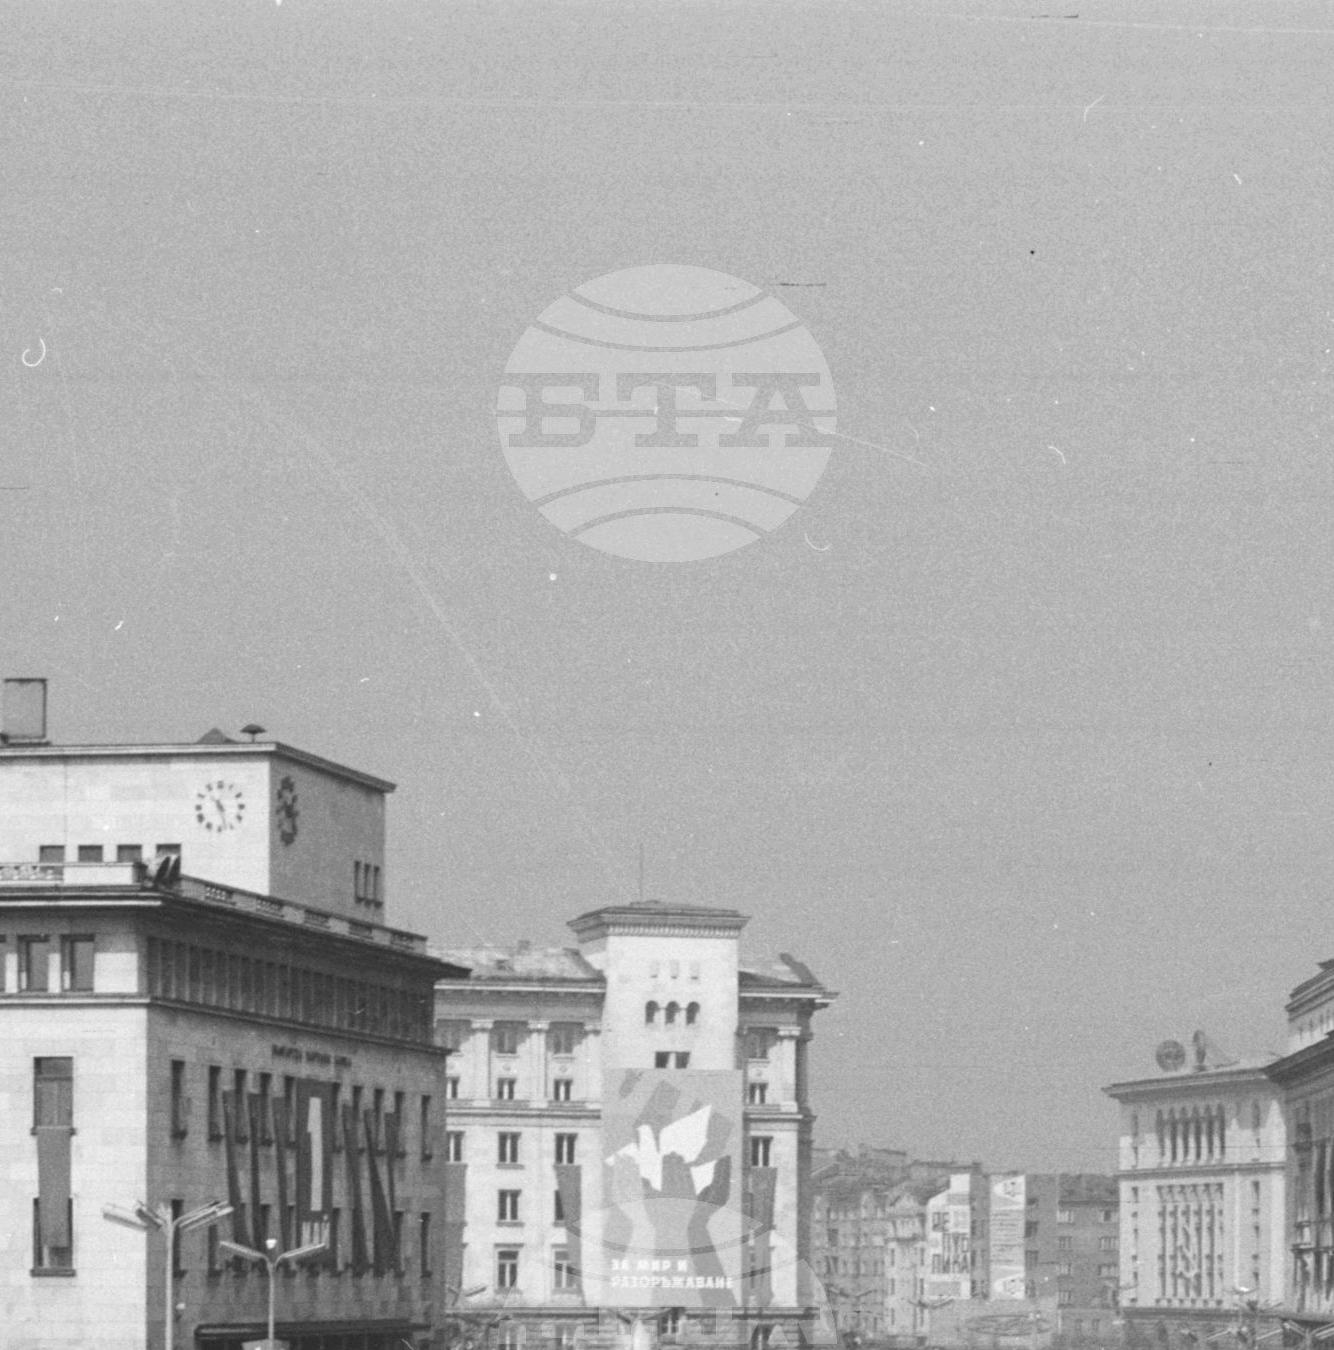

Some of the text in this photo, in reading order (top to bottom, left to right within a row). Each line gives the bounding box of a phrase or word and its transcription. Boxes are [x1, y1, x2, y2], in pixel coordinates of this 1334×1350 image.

[611, 1259, 688, 1272] ЗА МИР И
[610, 1275, 734, 1289] РАЗОРЪЖАВАНЕ
